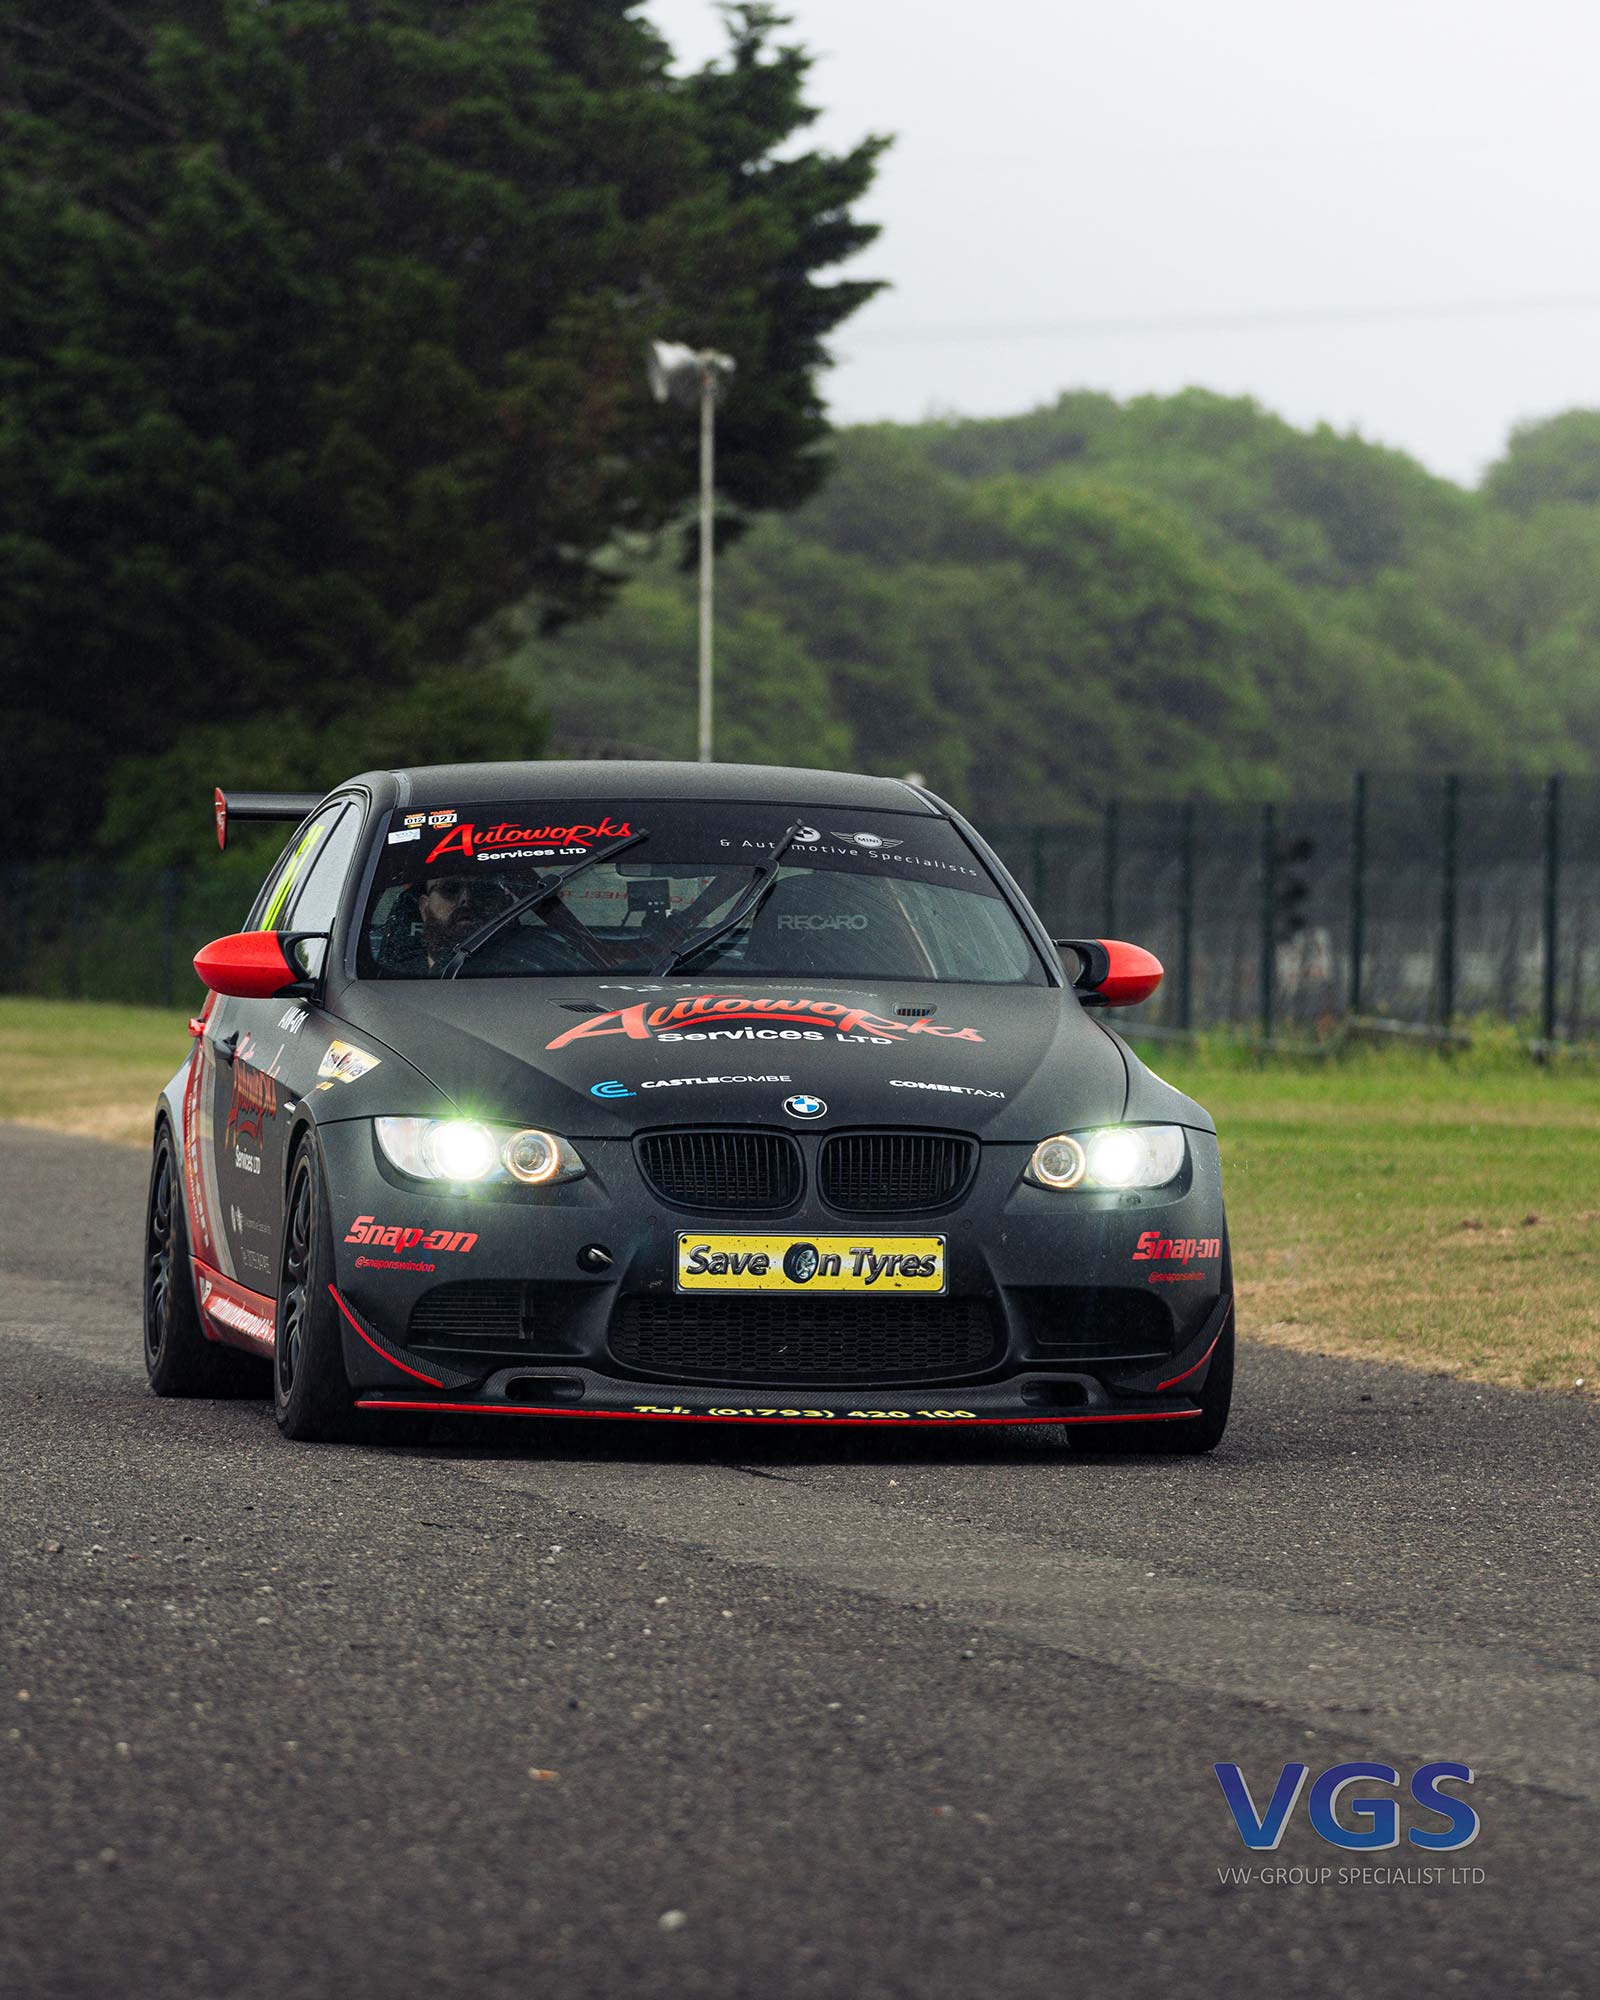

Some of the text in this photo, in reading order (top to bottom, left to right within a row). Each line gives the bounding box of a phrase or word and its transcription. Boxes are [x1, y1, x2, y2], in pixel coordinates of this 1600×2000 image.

[425, 817, 632, 864] Autoworks
[477, 847, 587, 862] Services LTD
[719, 838, 978, 877] & Autmotive Specialists
[857, 836, 880, 845] MINI
[777, 915, 869, 930] RECARO
[544, 994, 987, 1051] Autoworks
[656, 1026, 893, 1046] Services LTD
[343, 1215, 479, 1254] Snap-on
[1132, 1231, 1221, 1265] Snap-on
[686, 1244, 770, 1276] Save
[849, 1247, 937, 1285] Tyres
[633, 1406, 977, 1420] Tel: (01793) 420 100
